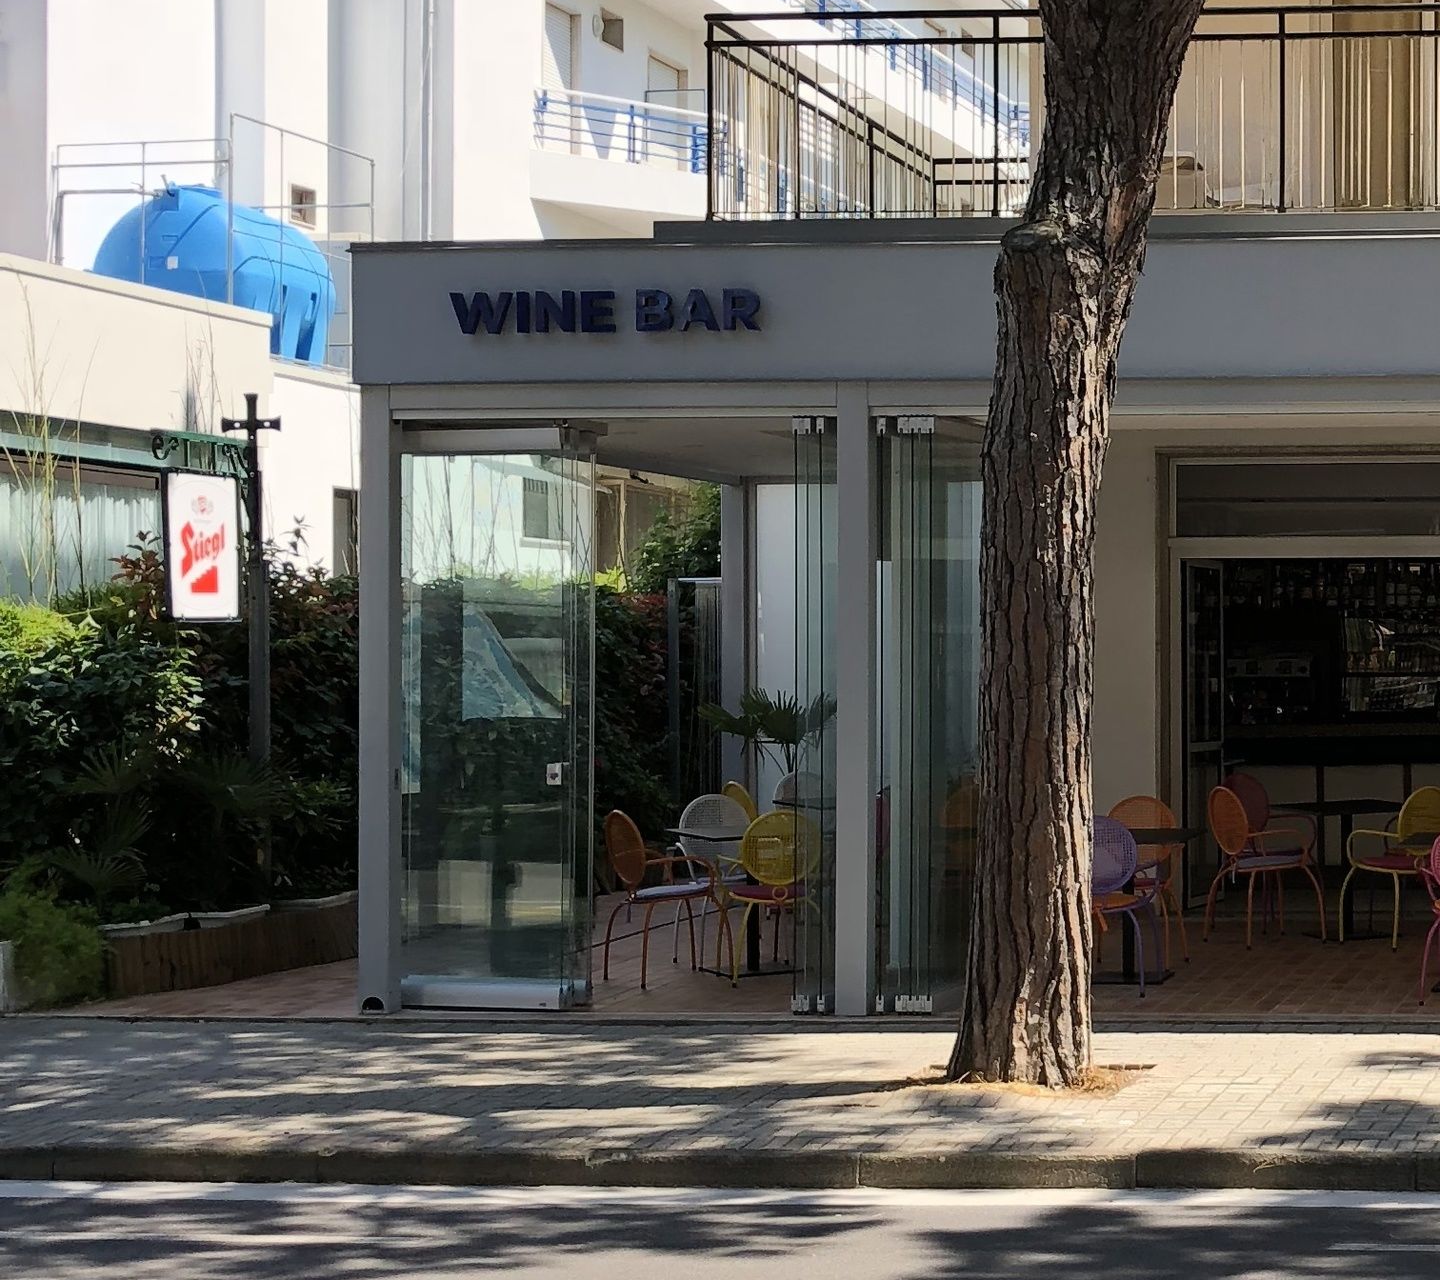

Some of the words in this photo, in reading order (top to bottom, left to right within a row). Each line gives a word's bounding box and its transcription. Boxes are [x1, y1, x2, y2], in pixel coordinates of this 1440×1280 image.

[449, 290, 617, 335] WINE
[635, 288, 762, 332] BAR
[181, 521, 226, 579] Stiegl
